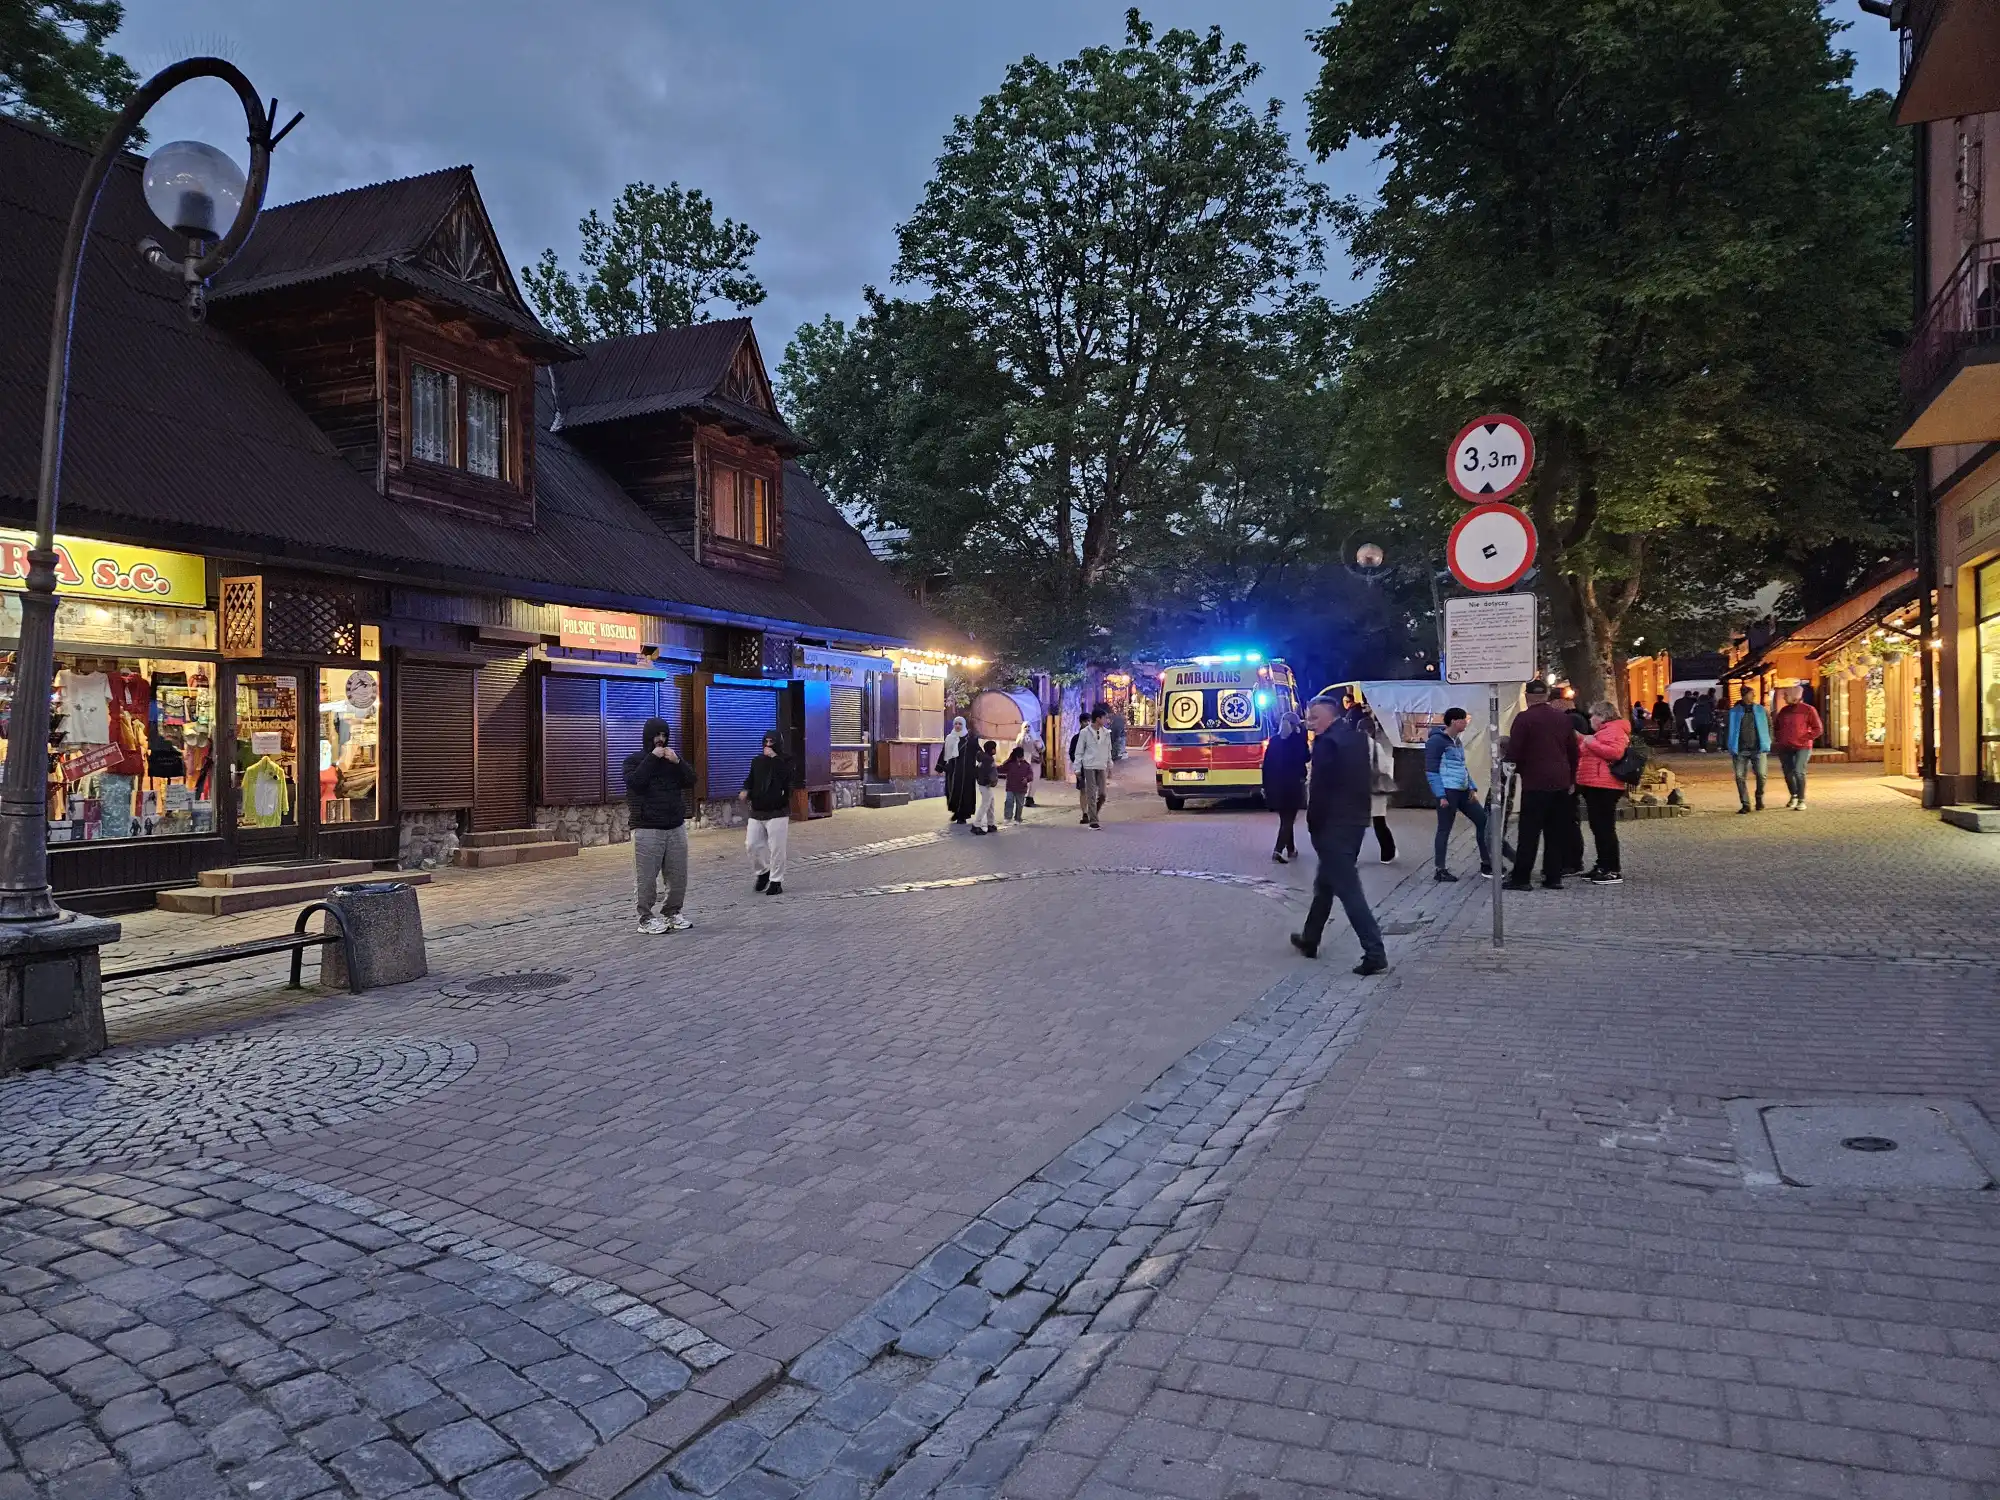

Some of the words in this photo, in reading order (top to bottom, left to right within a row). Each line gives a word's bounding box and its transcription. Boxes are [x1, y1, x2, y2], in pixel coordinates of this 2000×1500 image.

[563, 618, 597, 636] POLSKIE
[600, 622, 637, 640] KOSZULKI
[1175, 670, 1241, 685] AMBULANS
[1181, 702, 1191, 717] P
